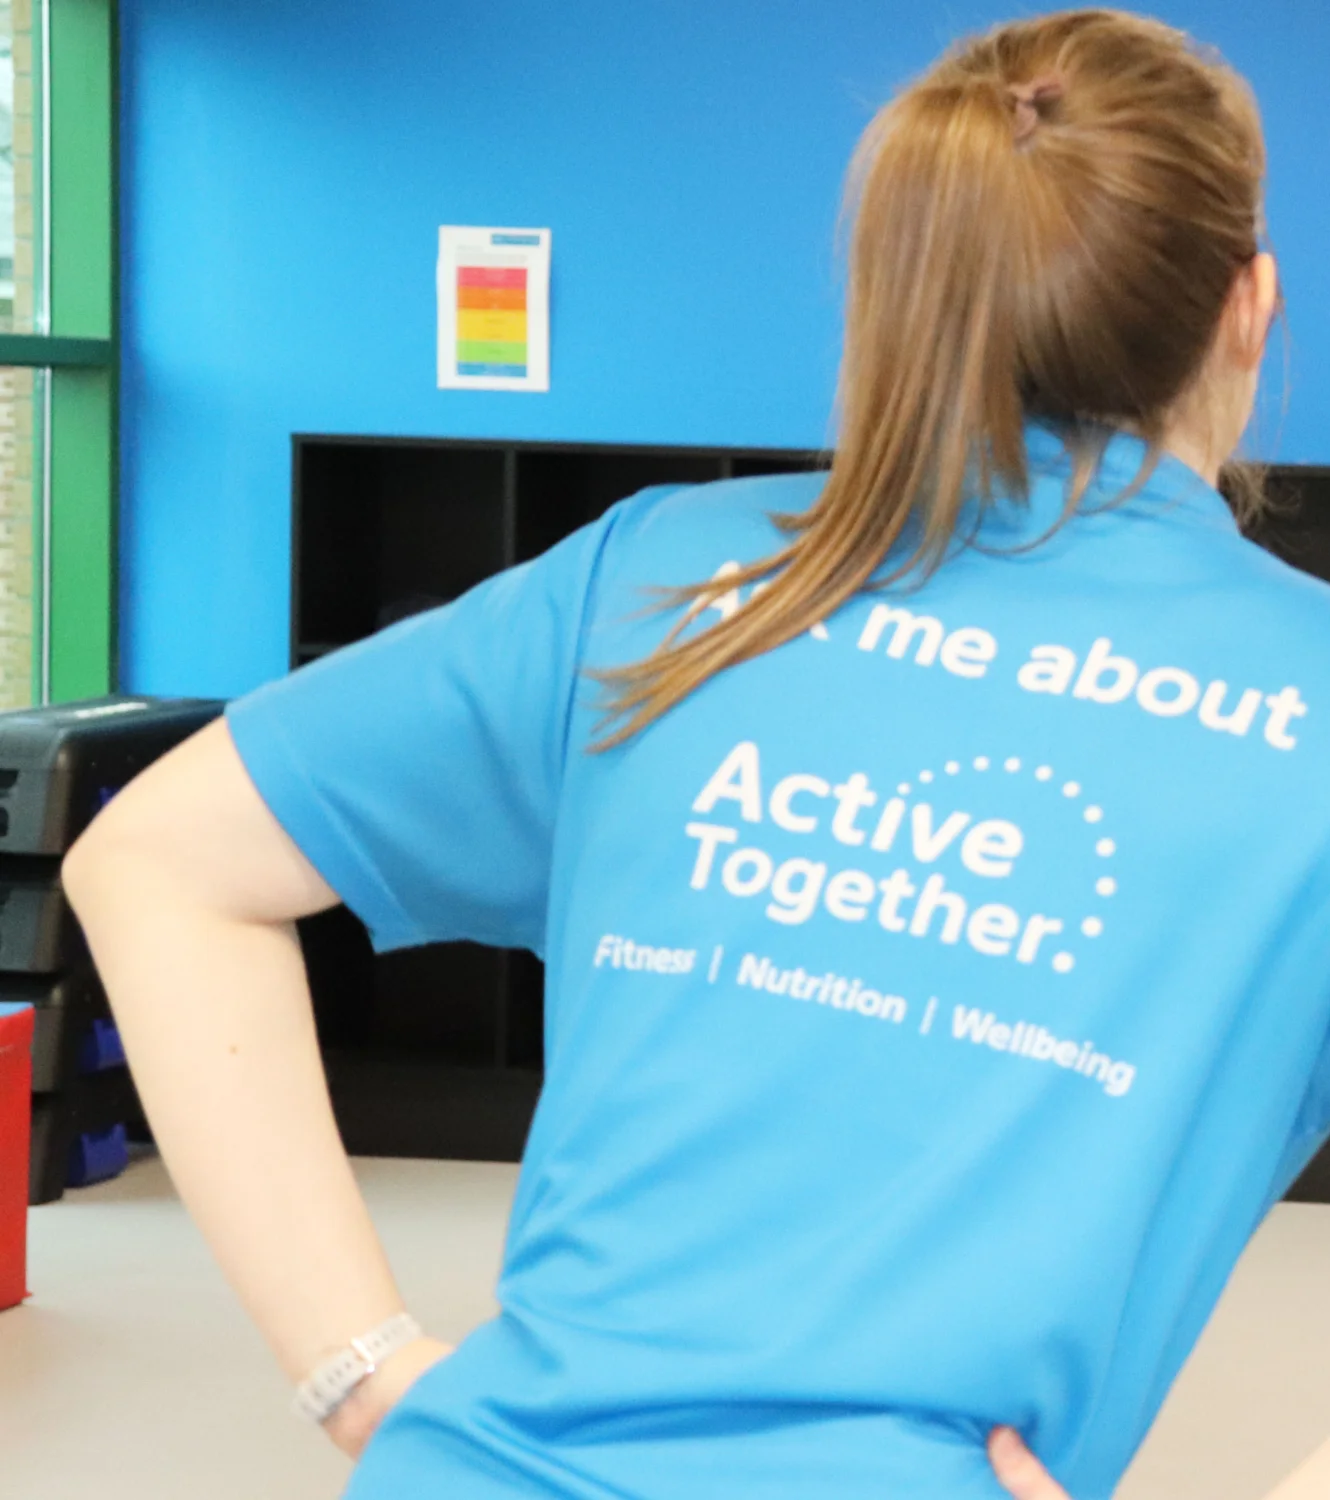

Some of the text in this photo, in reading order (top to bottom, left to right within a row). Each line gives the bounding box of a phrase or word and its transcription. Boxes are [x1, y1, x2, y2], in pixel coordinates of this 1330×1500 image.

[857, 602, 1308, 751] me about
[690, 740, 1024, 878] Active
[593, 933, 697, 974] Fitness
[736, 952, 907, 1024] Nutrition
[951, 1004, 1136, 1097] Wellbeing
